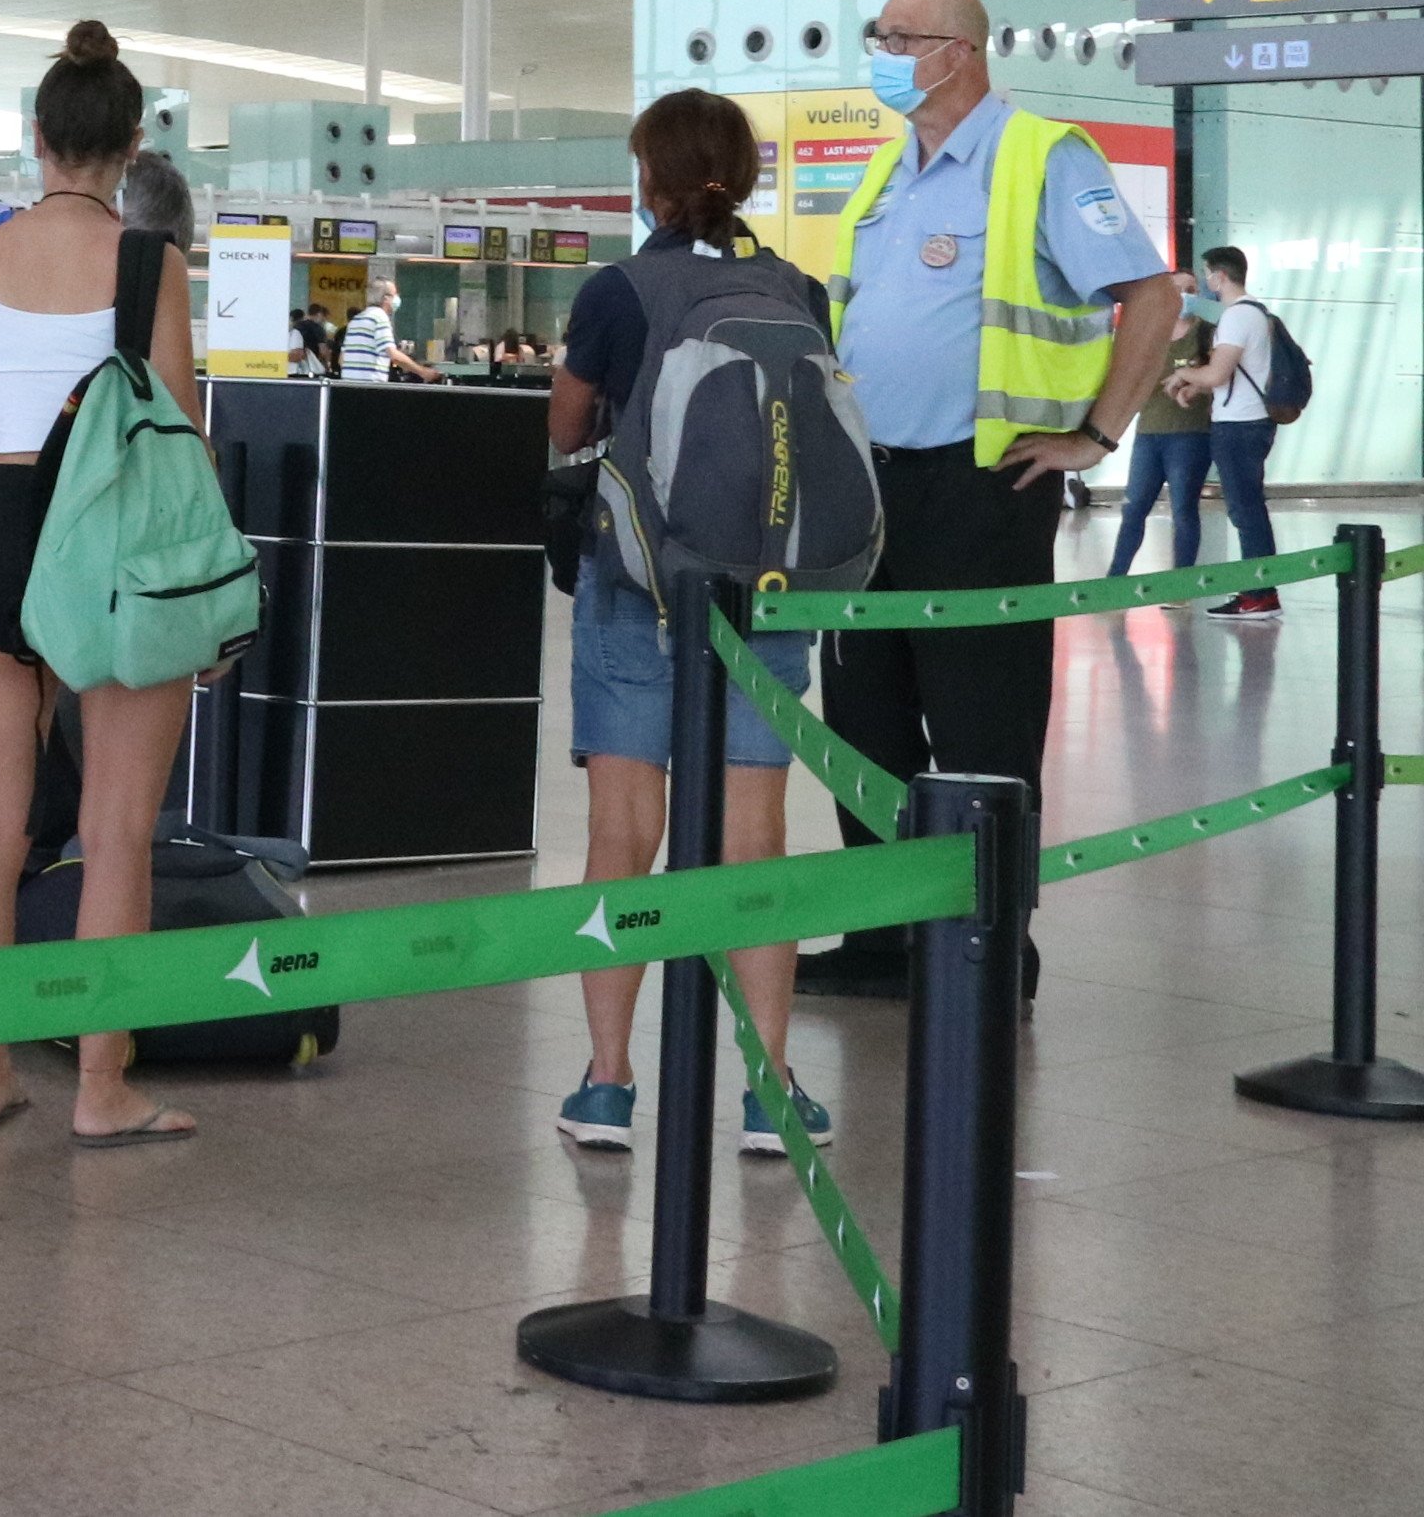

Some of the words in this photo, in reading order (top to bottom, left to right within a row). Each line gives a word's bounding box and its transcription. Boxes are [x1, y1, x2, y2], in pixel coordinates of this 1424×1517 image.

[807, 101, 880, 129] vueling
[824, 147, 845, 156] LAST
[219, 251, 269, 261] CHECK-IN
[245, 361, 279, 372] vueling
[768, 400, 791, 527] TRIBORD
[614, 907, 661, 932] aena
[270, 950, 320, 974] aena
